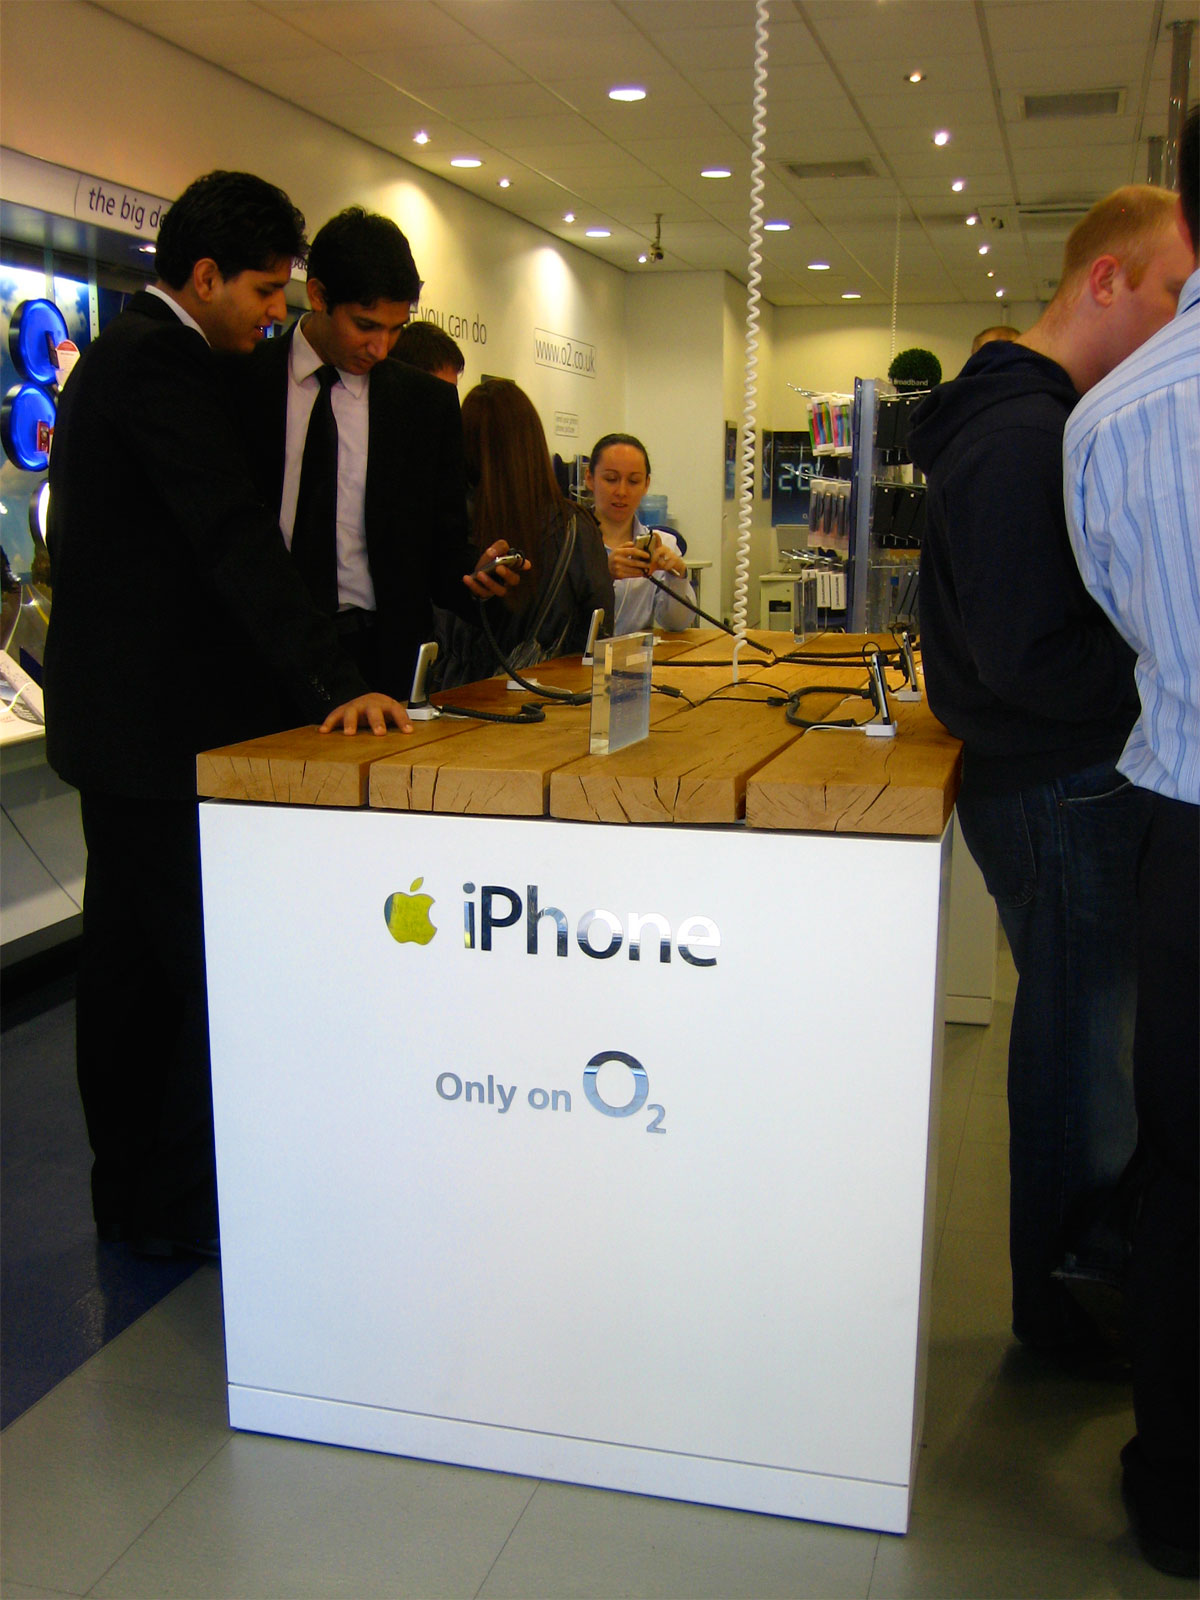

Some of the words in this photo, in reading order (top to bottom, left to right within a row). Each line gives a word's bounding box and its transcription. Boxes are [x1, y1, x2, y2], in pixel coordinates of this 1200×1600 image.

[89, 186, 116, 216] the
[120, 194, 145, 230] big
[448, 314, 469, 340] can
[472, 312, 488, 345] do
[535, 339, 596, 373] www.o2.co.uk
[462, 881, 722, 968] iPhone
[435, 1071, 517, 1114] Only
[527, 1087, 572, 1113] on
